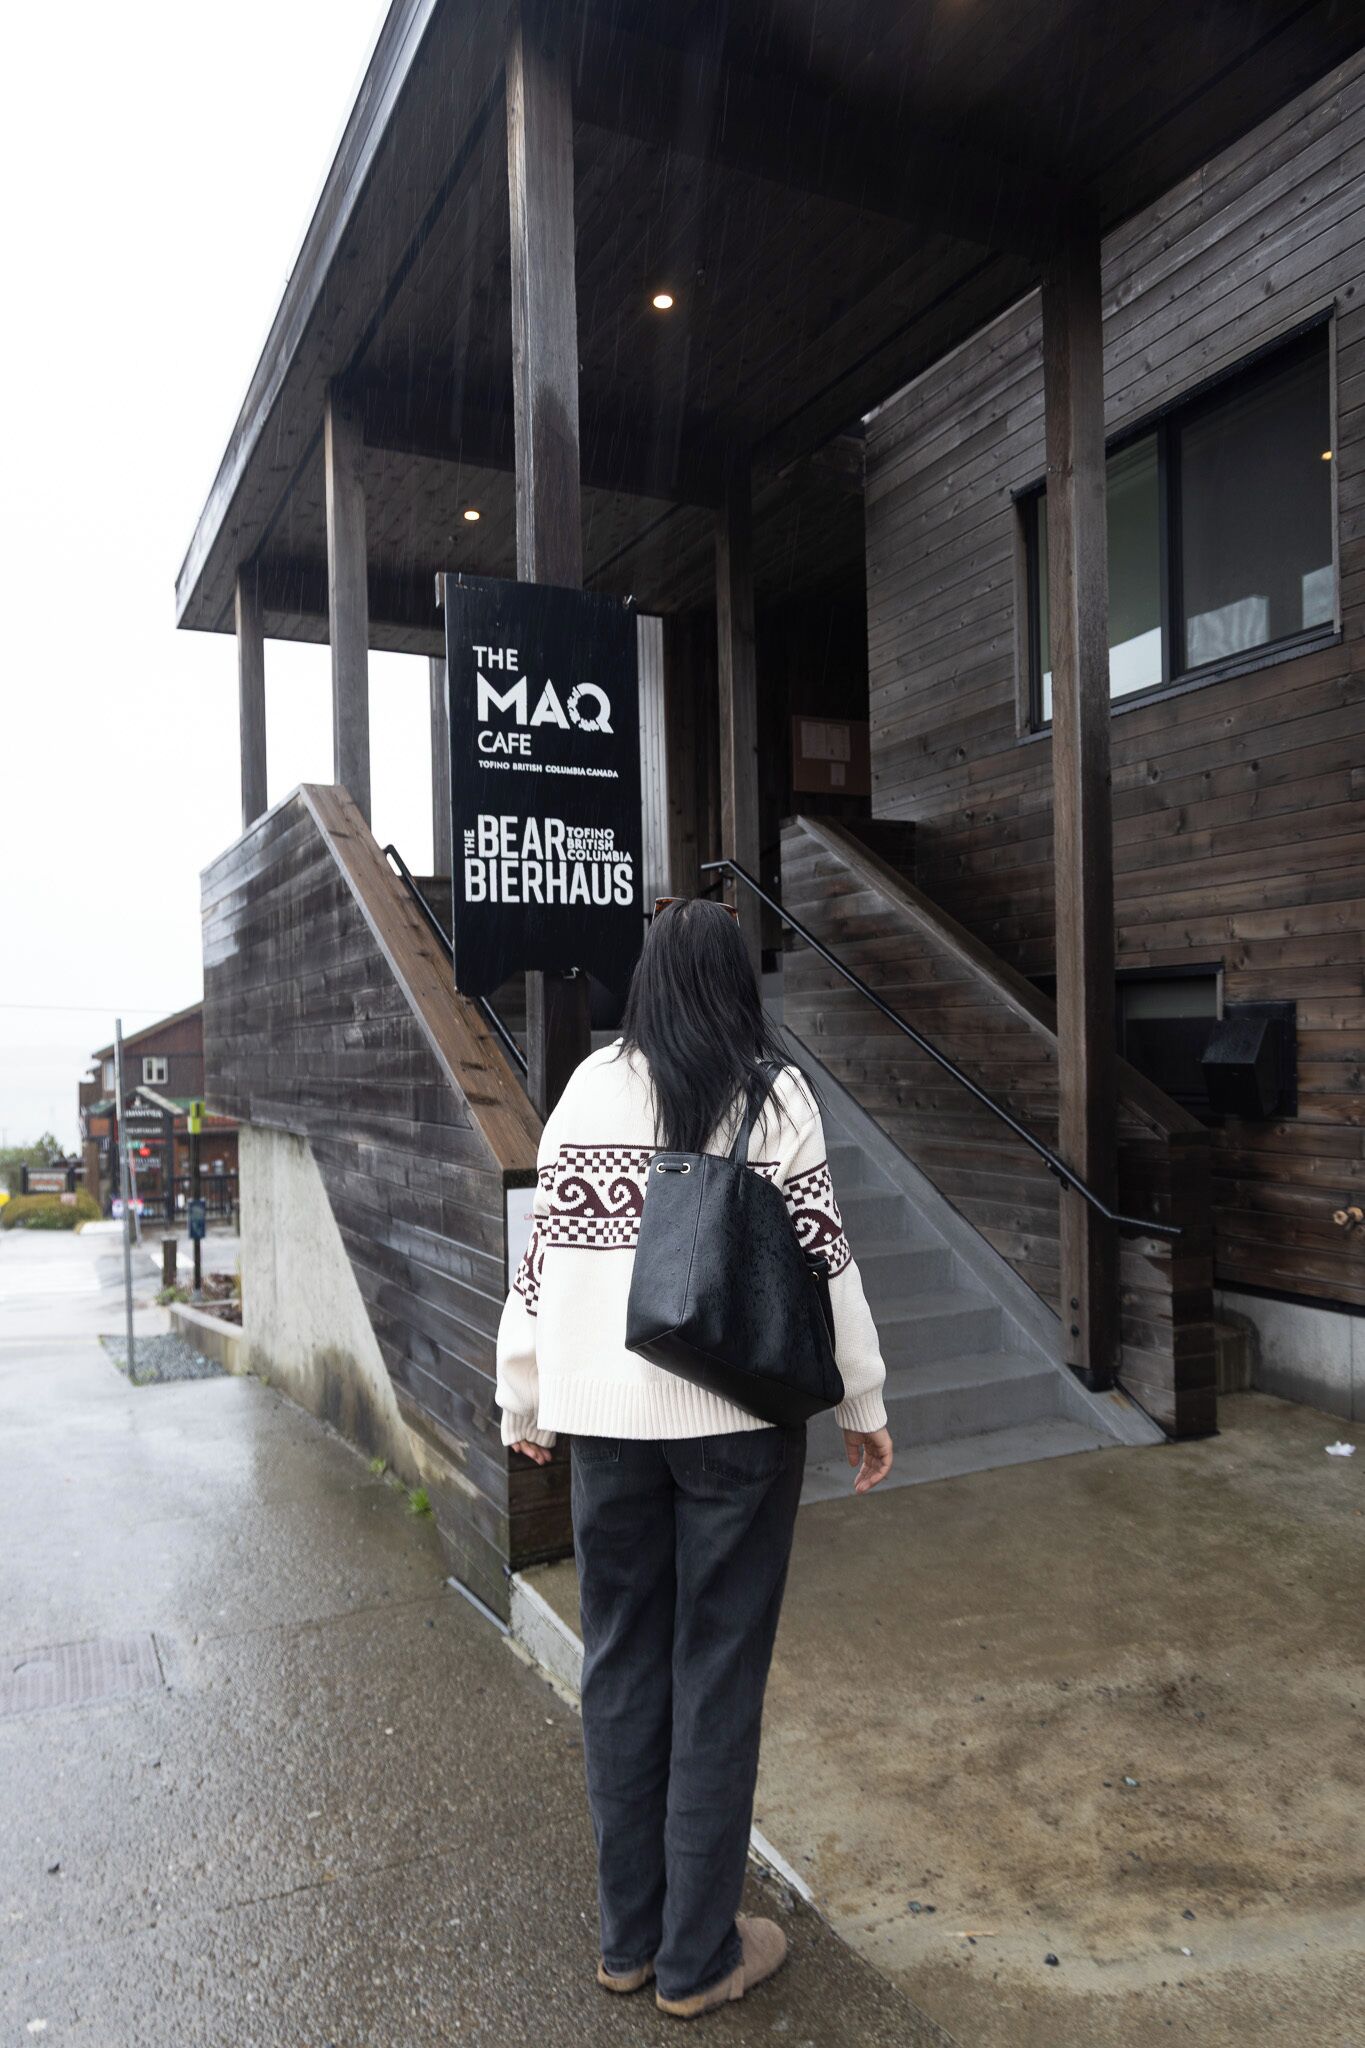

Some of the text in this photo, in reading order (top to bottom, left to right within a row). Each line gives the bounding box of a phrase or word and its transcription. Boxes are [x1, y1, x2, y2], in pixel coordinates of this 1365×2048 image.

[471, 645, 519, 671] THE
[477, 671, 614, 734] MAQ
[478, 730, 532, 755] CAFE
[478, 759, 619, 778] TOFINO BRITISH COLUMBIA CANADA
[464, 814, 567, 861] THE BEAR
[566, 826, 615, 840] TOFINO
[566, 838, 614, 851] BRITISH
[567, 850, 633, 862] COLUMBIA
[464, 857, 634, 906] BIERHAUS
